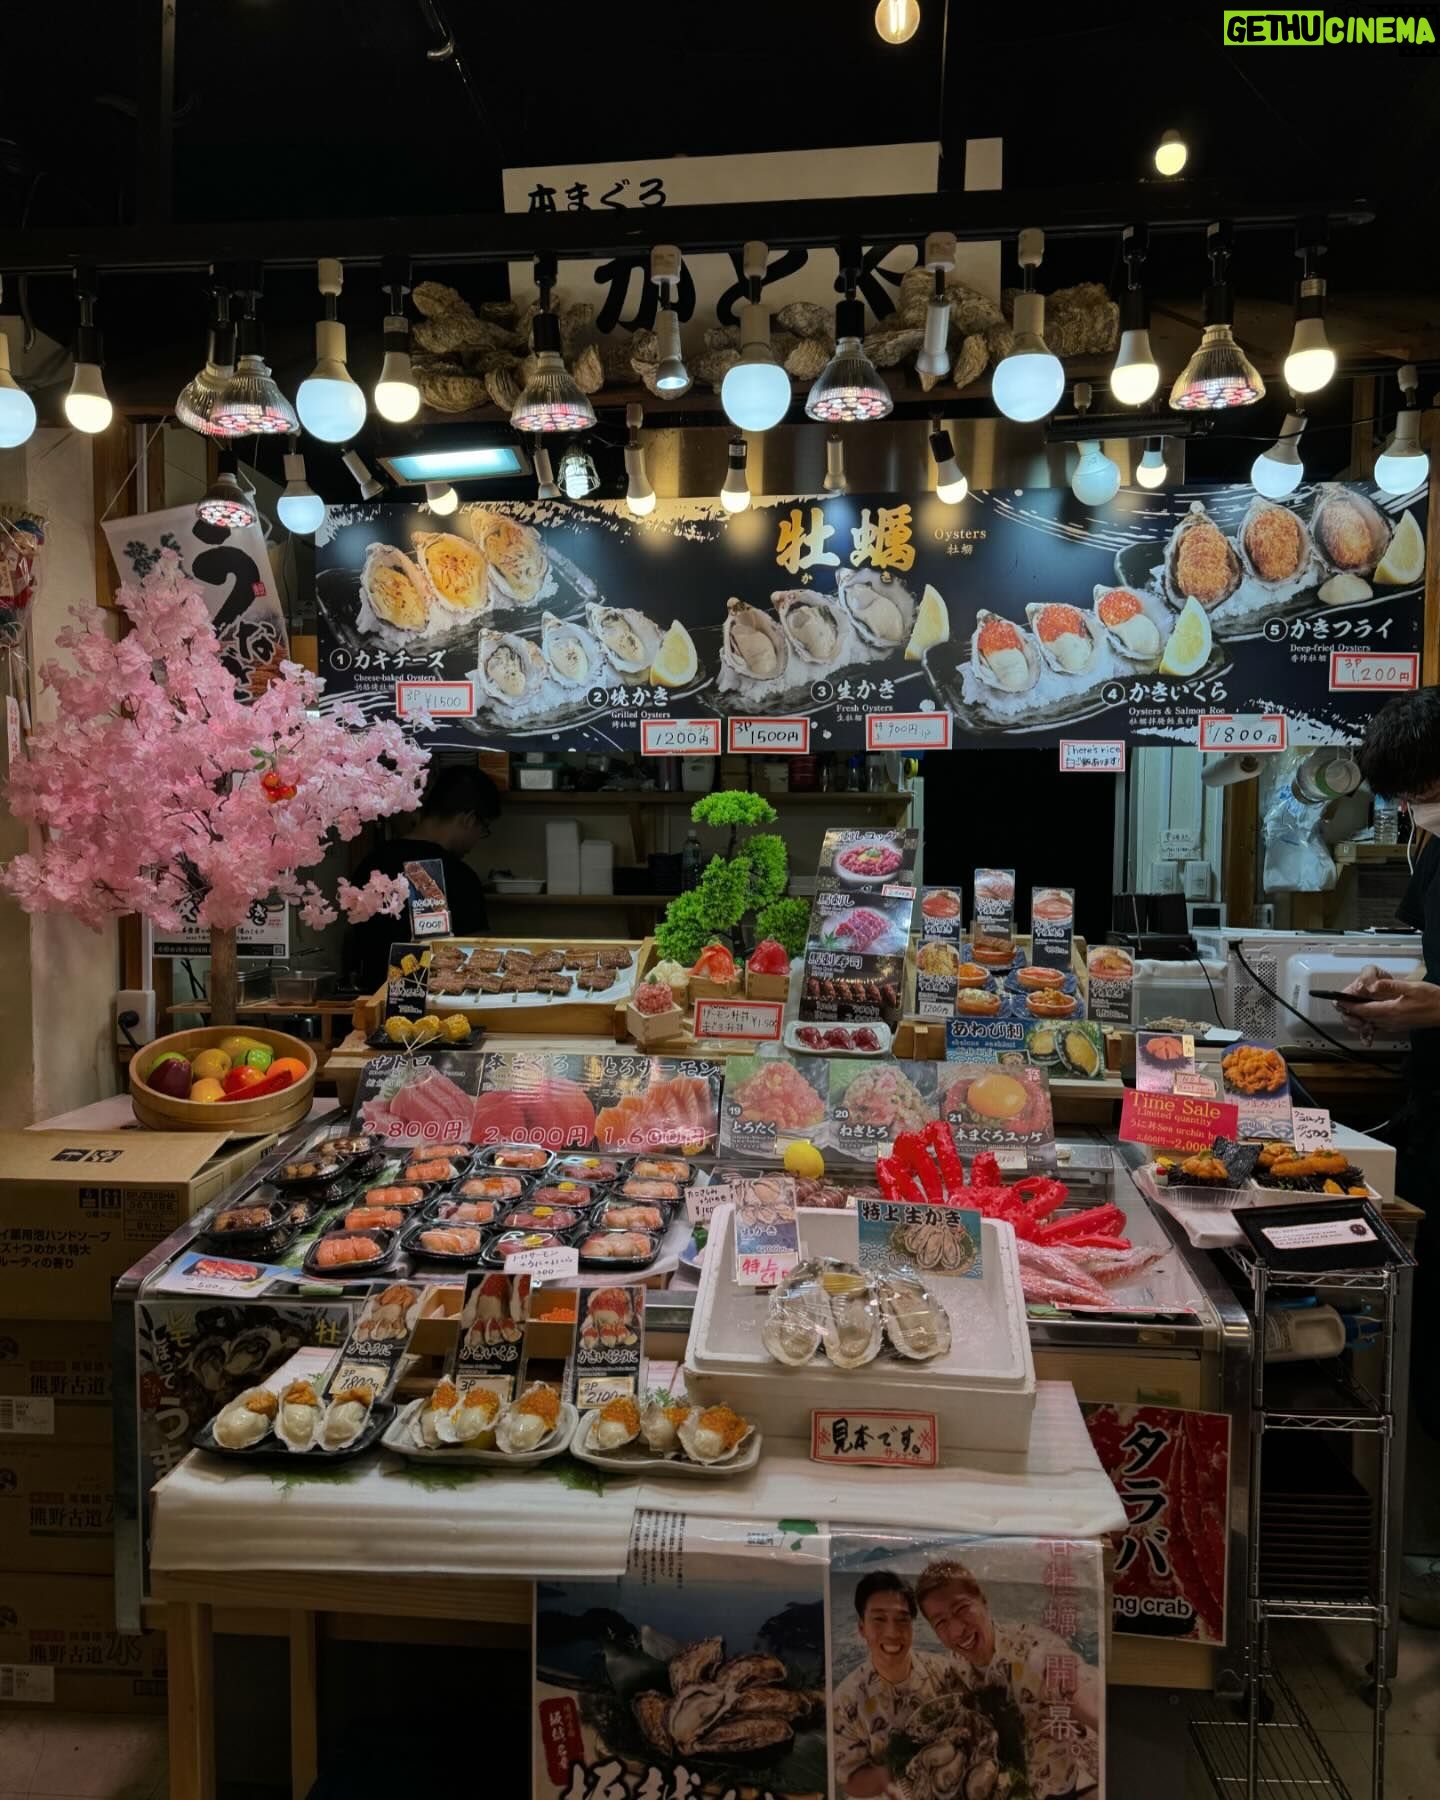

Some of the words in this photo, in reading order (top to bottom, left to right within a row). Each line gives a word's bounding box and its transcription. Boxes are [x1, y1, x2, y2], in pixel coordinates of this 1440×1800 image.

[526, 177, 667, 214] 本まぐろ
[934, 528, 987, 541] Oysters
[1289, 618, 1394, 640] かきフライ
[1289, 643, 1335, 653] Deep-fried
[1337, 643, 1371, 653] Oysters
[353, 649, 448, 670] カキチーズ
[353, 673, 404, 682] Cheese-baked
[406, 673, 436, 682] Oysters
[610, 686, 670, 707] 焼かき
[837, 678, 896, 701] 生かき
[1129, 680, 1228, 703] かきいくら
[611, 710, 638, 719] Grilled
[641, 711, 671, 720] Oysters
[836, 704, 859, 713] Fresh
[862, 704, 894, 713] Oysters
[1129, 707, 1162, 716] Oysters
[1164, 707, 1171, 715] &
[1174, 706, 1206, 715] Salmon
[1209, 706, 1225, 715] Roe
[734, 720, 752, 732] 3P
[751, 729, 799, 745] 1500円
[371, 1054, 432, 1070] 中トロ
[604, 1056, 720, 1079] とろサーモン
[728, 1106, 741, 1115] 19
[1129, 1091, 1176, 1112] Time
[1182, 1098, 1221, 1119] Sale
[834, 1110, 849, 1118] 20
[948, 1113, 962, 1122] 21
[1136, 1108, 1172, 1120] Limited
[1174, 1114, 1212, 1126] quantity
[731, 1120, 777, 1134] とろたく
[839, 1124, 889, 1138] ねぎとろ
[1176, 1126, 1205, 1138] urchin
[955, 1128, 1043, 1143] 本まぐろユッケ
[862, 1200, 961, 1228] 特上生かき
[459, 1344, 519, 1362] かきいくら
[831, 1417, 921, 1455] 見本です。
[1113, 1422, 1171, 1577] タラバ
[1141, 1593, 1192, 1617] crab
